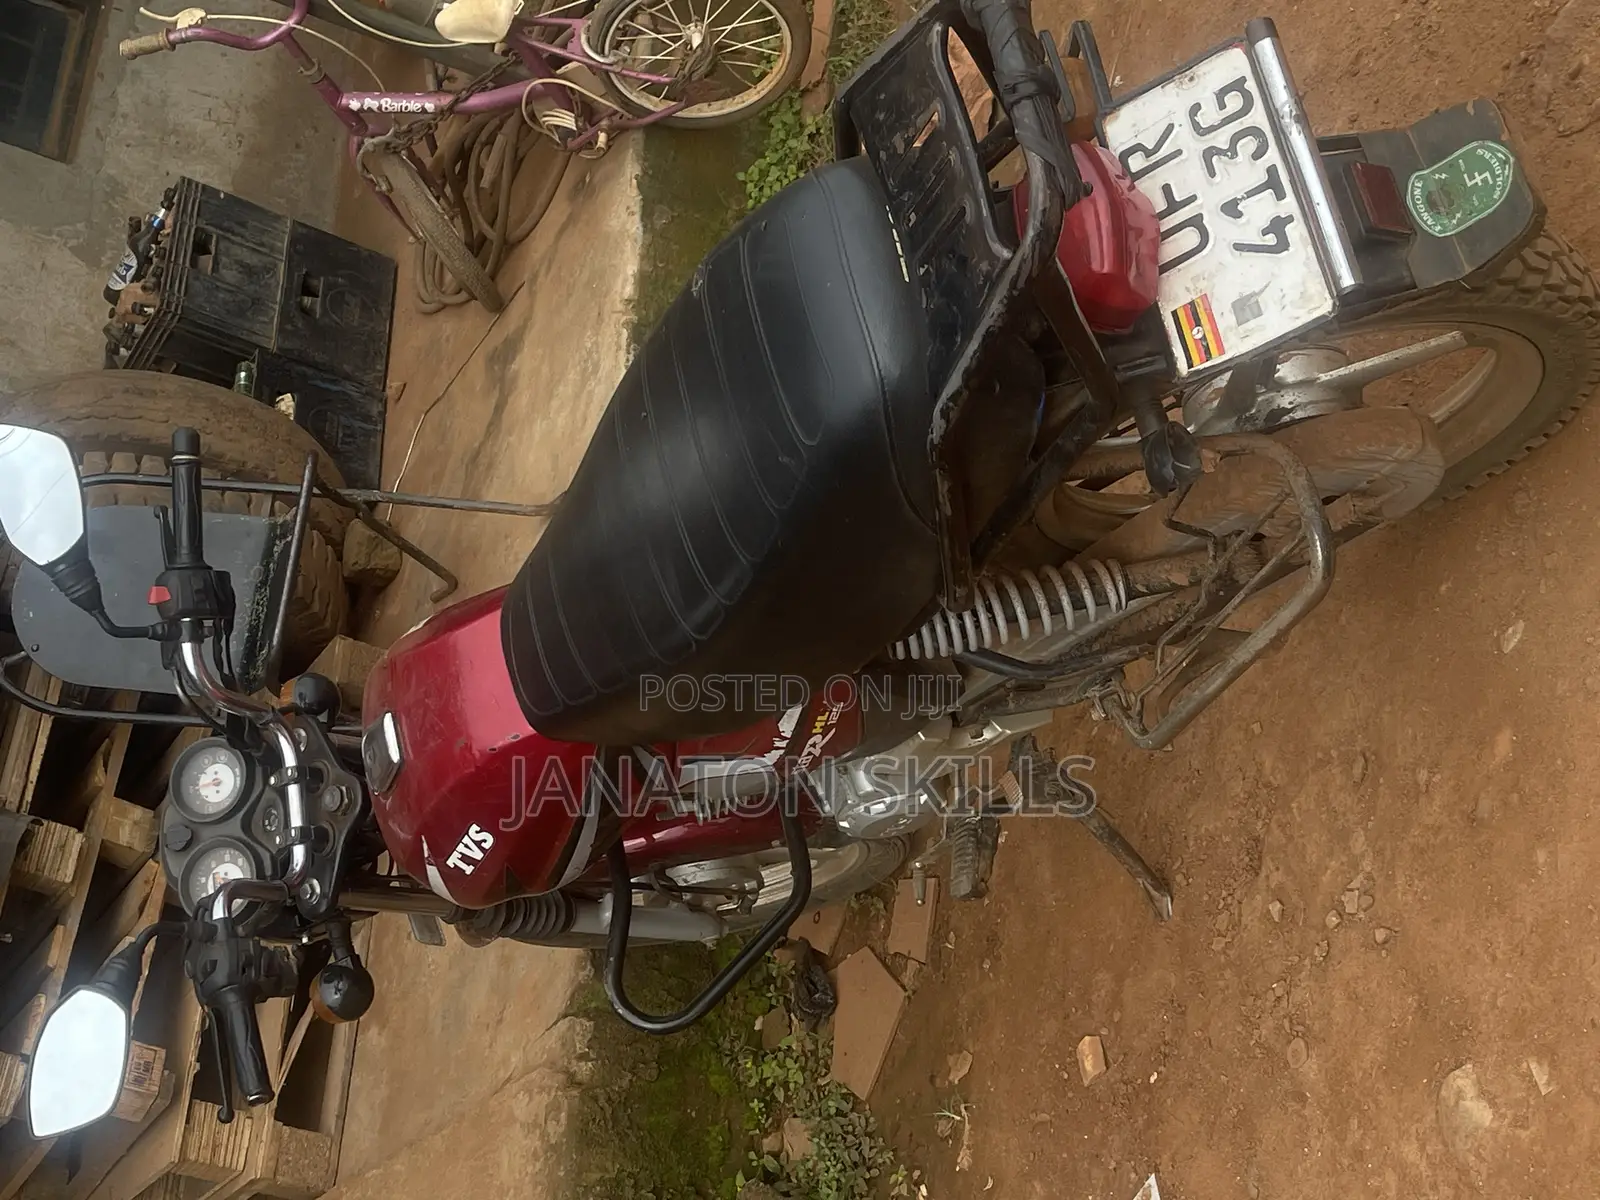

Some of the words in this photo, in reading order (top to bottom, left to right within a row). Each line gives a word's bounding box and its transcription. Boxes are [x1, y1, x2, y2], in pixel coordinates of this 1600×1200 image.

[380, 98, 422, 113] Barbie
[1189, 76, 1294, 255] 413G
[446, 823, 494, 875] TVS
